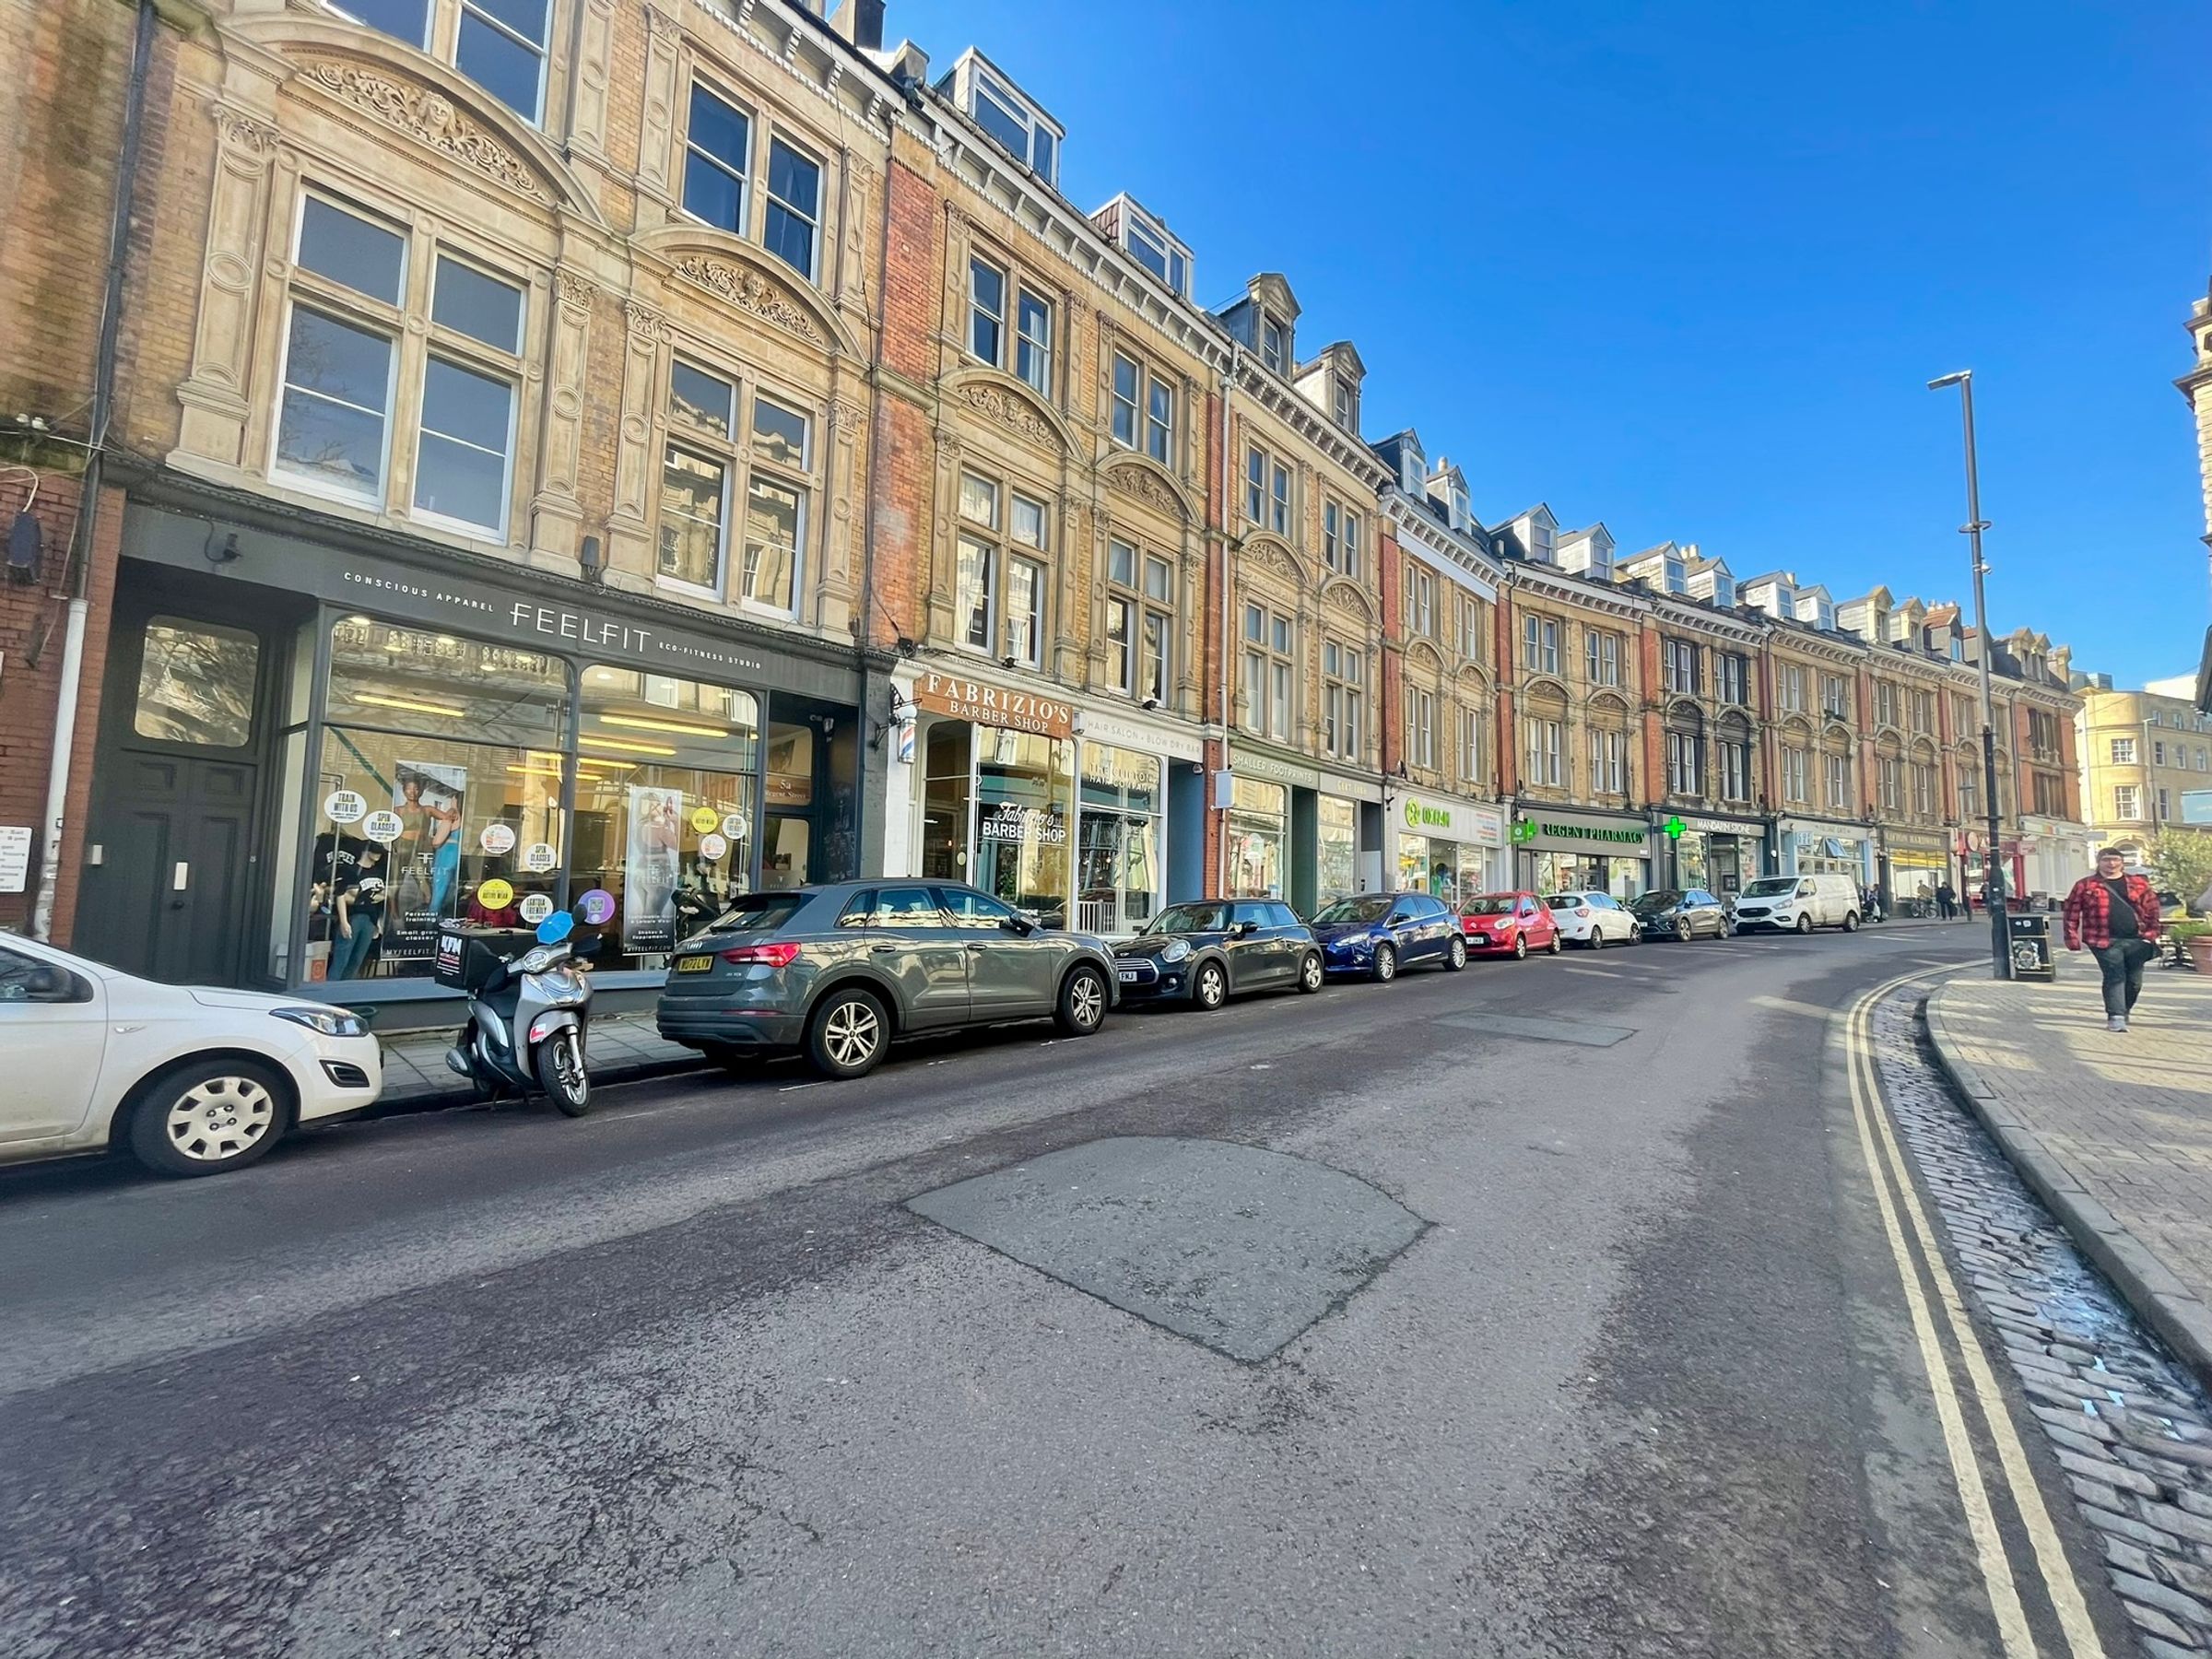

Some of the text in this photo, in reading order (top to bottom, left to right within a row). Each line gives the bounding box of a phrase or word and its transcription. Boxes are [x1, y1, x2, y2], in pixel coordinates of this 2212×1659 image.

[344, 571, 494, 613] CONSCIOUS APPAREL
[510, 602, 652, 653] FEELFIT
[659, 641, 761, 669] ECO-FITNESS STUDIO
[927, 674, 1068, 724] FABRIZIO'S
[950, 700, 1048, 733] BARBER SHOP
[1088, 722, 1199, 753] HAIR SALON BLOW DRY BAR
[1233, 754, 1312, 782] SMALLER FOOTPRINTS
[997, 801, 1054, 826] Fabrizio's
[1422, 807, 1450, 828] OXFAM
[982, 821, 1065, 842] BARBER SHOP
[1543, 823, 1645, 844] REGENT PHARMACY
[401, 865, 449, 876] FEELFIT
